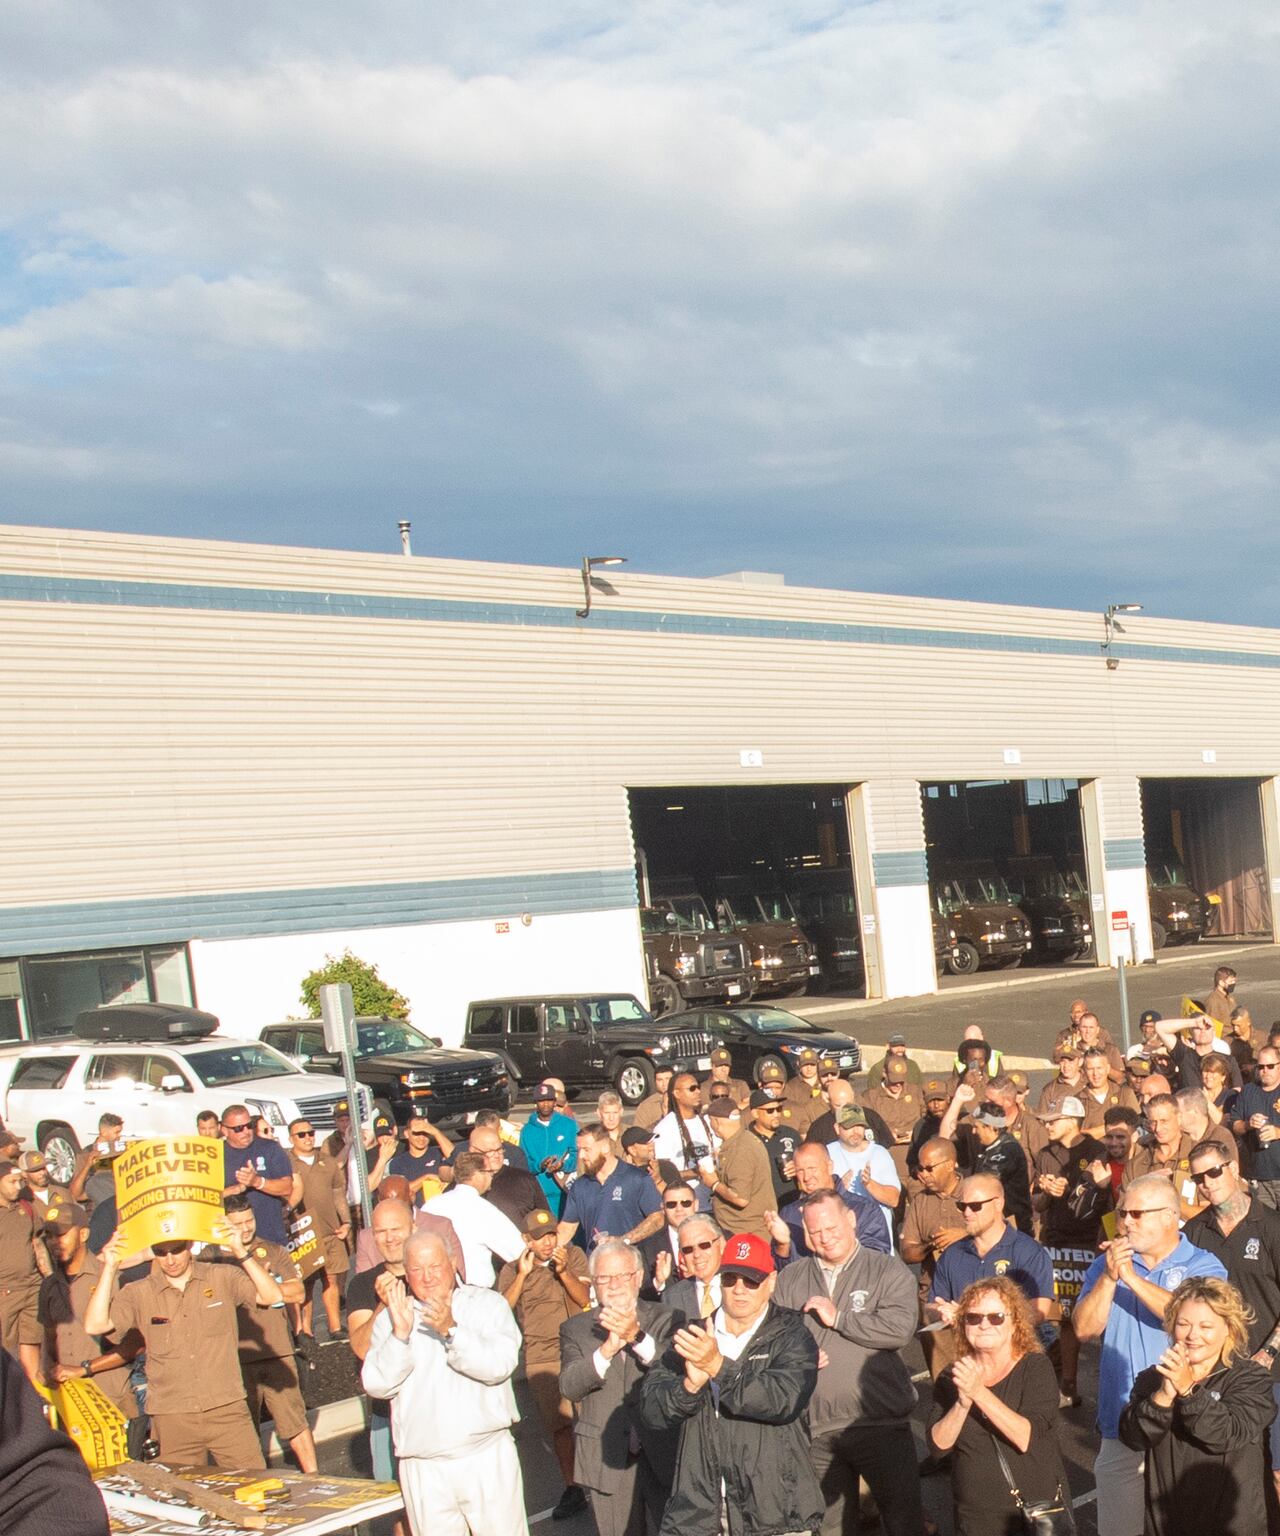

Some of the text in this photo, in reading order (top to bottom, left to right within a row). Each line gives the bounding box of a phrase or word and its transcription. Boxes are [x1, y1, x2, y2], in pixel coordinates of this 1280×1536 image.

[118, 1143, 167, 1178] MAKE
[173, 1142, 218, 1160] UPS
[125, 1159, 210, 1189] DELIVER
[121, 1186, 221, 1221] WORKING FAMILIES
[290, 1238, 318, 1263] RACT
[735, 1241, 751, 1260] B
[1053, 1268, 1087, 1282] RON
[63, 1380, 107, 1469] WORKING FAMI
[84, 1389, 122, 1463] DELIVE
